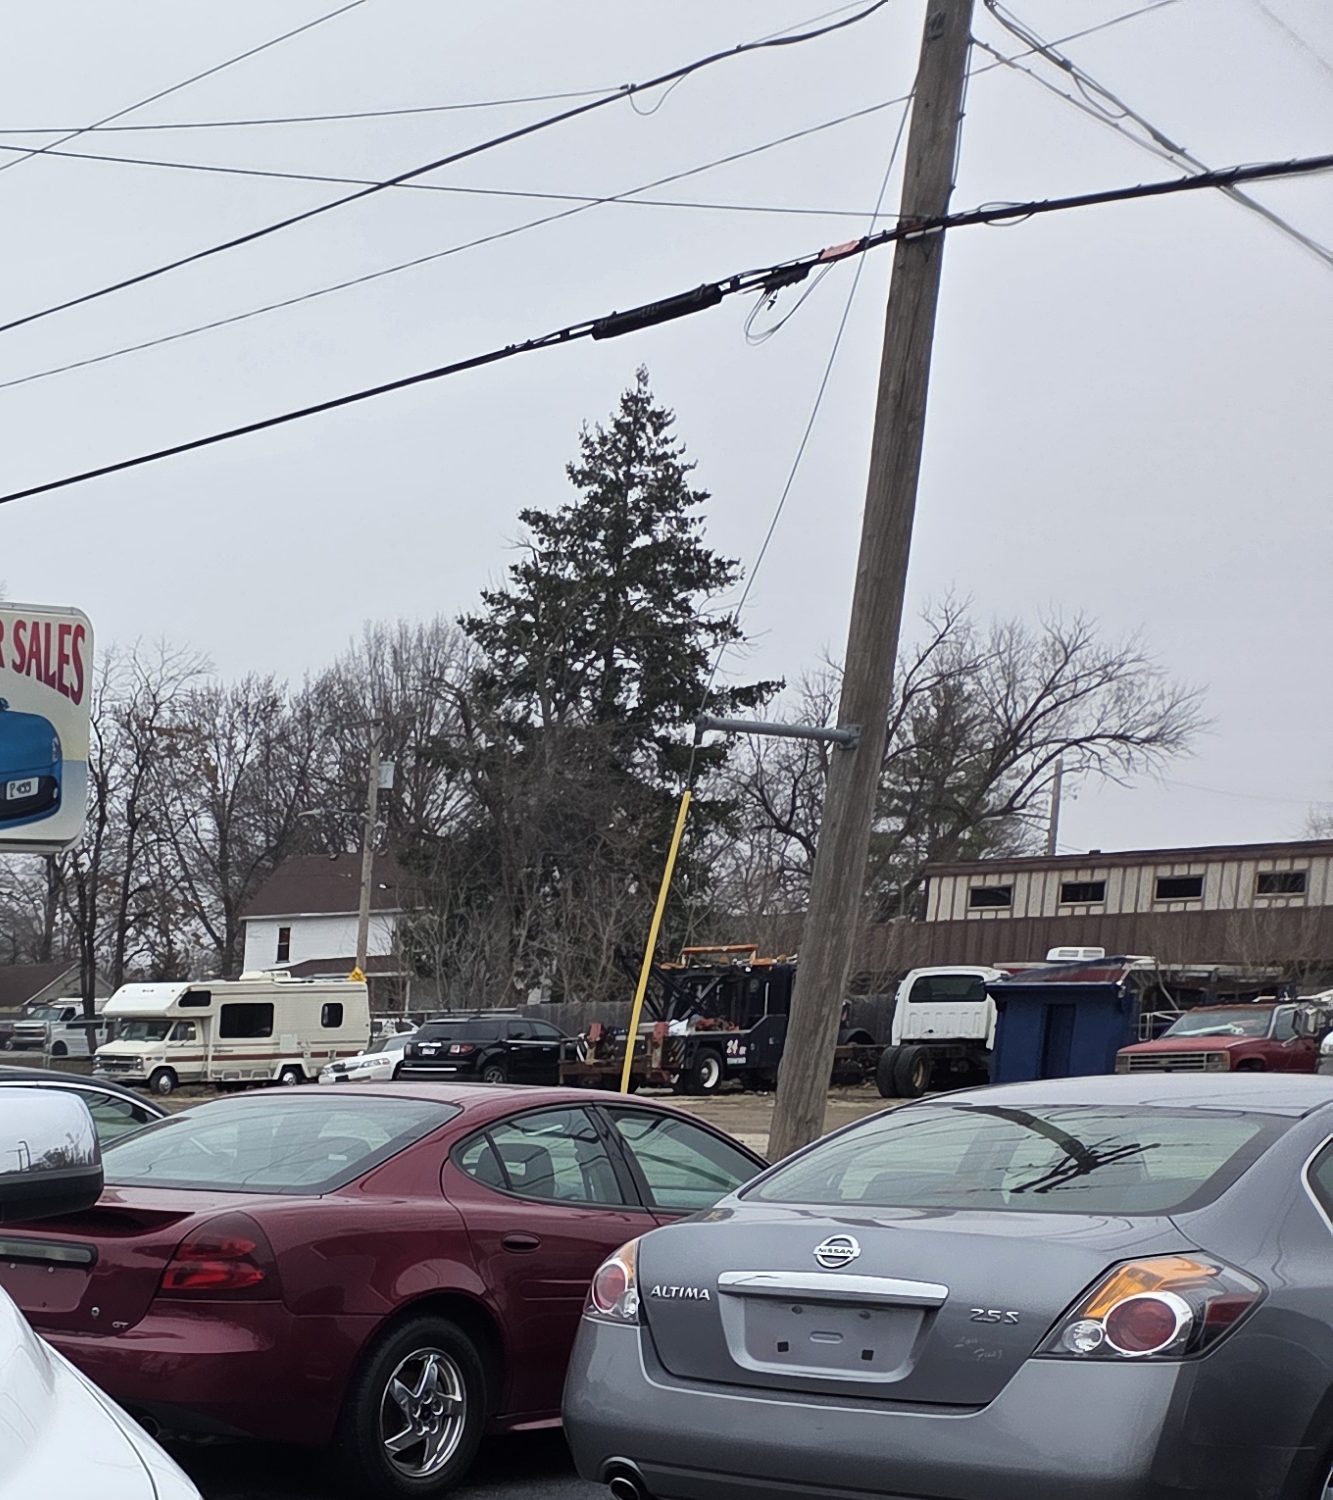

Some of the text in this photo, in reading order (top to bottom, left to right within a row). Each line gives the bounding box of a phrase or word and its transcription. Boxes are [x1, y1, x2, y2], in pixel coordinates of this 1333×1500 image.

[12, 619, 86, 706] SALES
[818, 1247, 854, 1255] NISSAN
[651, 1285, 710, 1300] ALTIMA
